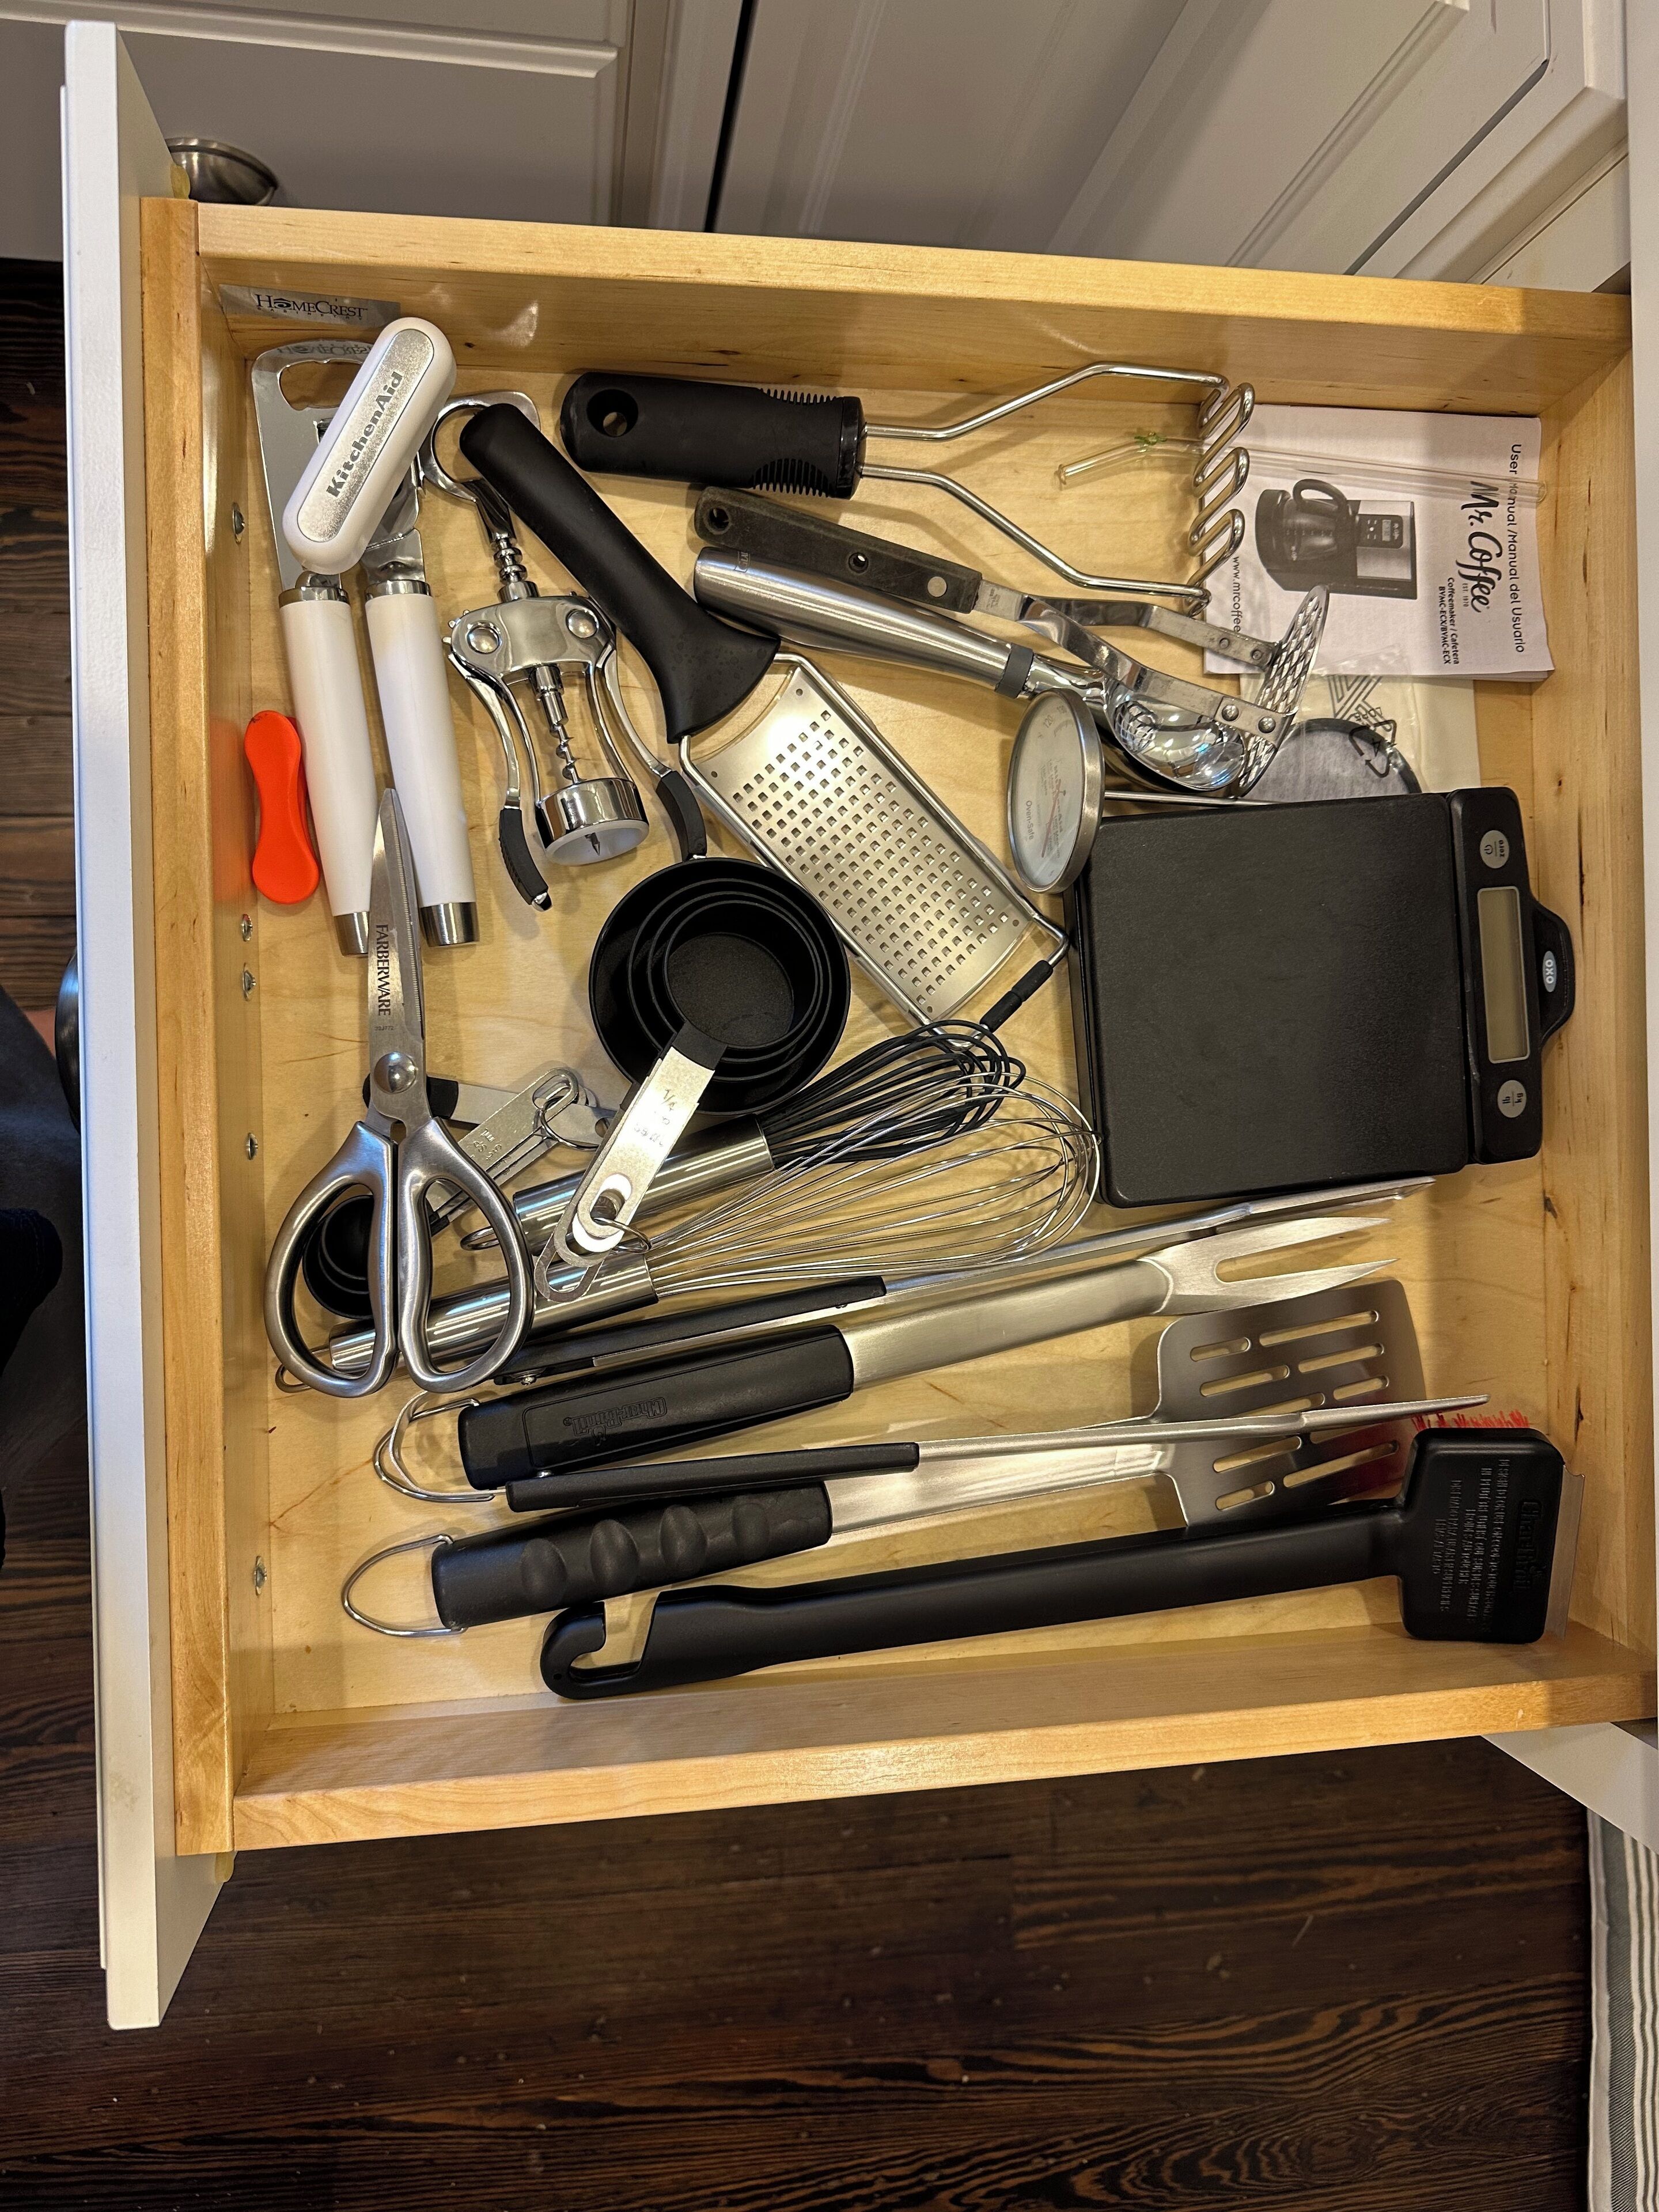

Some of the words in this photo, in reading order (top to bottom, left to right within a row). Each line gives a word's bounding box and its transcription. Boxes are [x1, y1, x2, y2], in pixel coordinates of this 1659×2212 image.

[327, 371, 403, 497] KitchenAid
[1509, 444, 1521, 475] User
[1461, 480, 1499, 527] Mr.
[1456, 532, 1502, 613] Coffee
[1508, 529, 1520, 580] /Manual
[1448, 577, 1456, 627] Coffeemaker
[1510, 584, 1521, 604] del
[1438, 586, 1451, 665] BVMC-ECX/BVMC-ECX
[1512, 607, 1526, 653] Usuario
[1450, 633, 1460, 665] Cafetera
[1042, 714, 1054, 728] 120
[1025, 800, 1035, 841] Oven-Safe
[376, 924, 391, 1016] FARBERWARE
[1545, 959, 1554, 984] OXO
[1502, 1096, 1510, 1104] lb
[1514, 1093, 1524, 1103] kg
